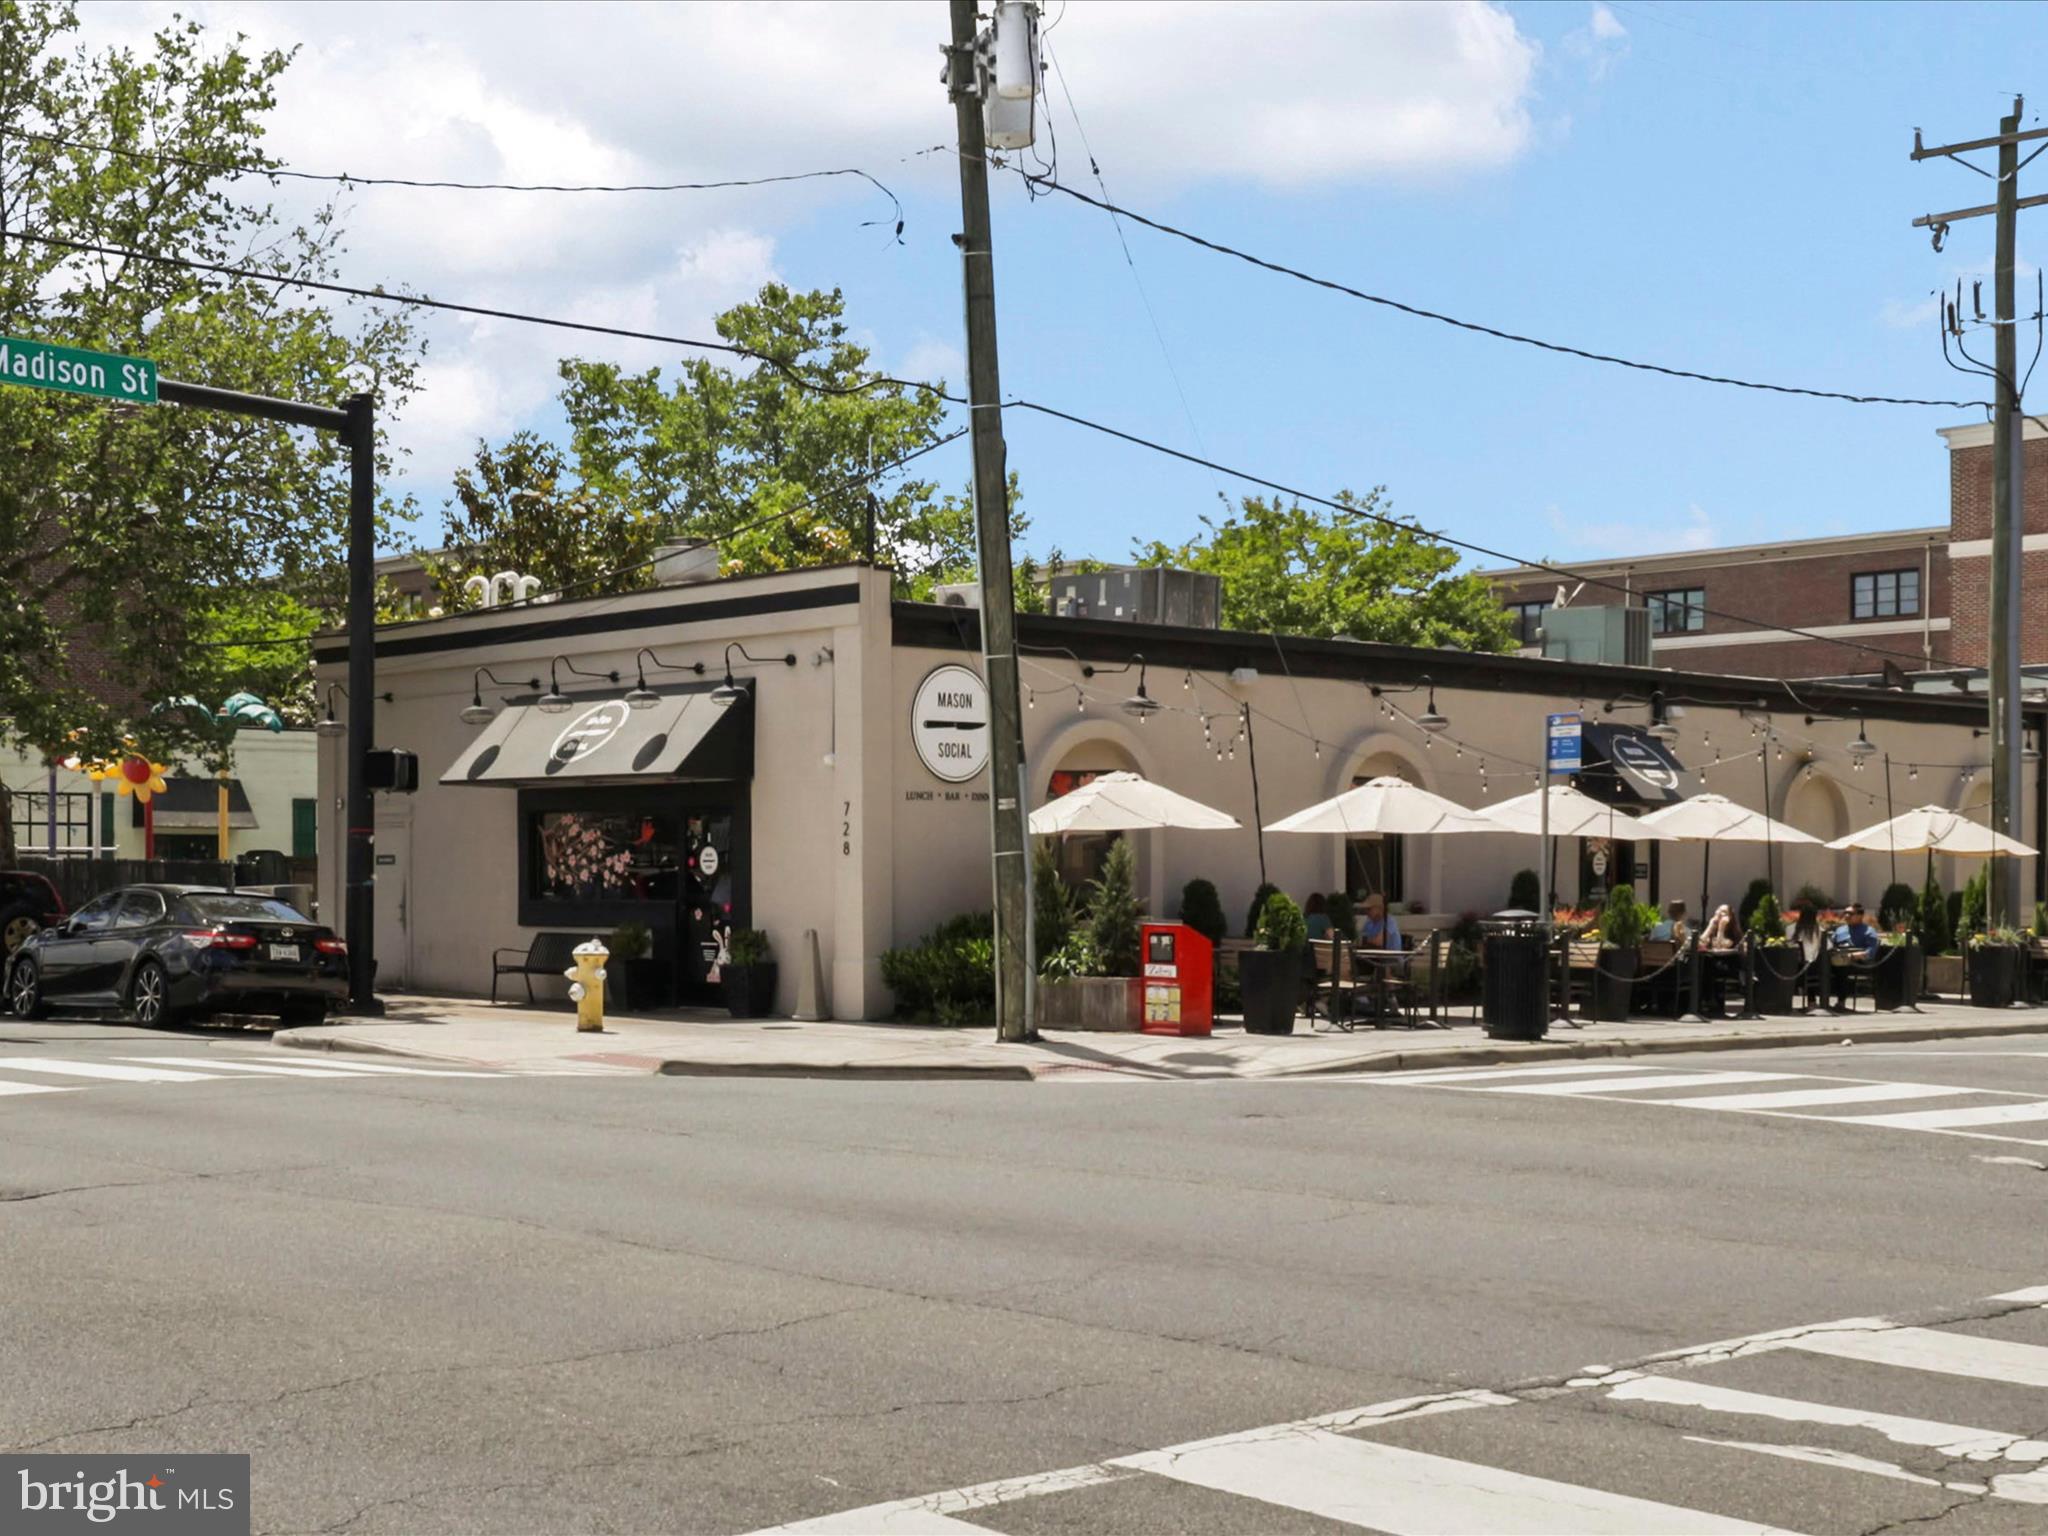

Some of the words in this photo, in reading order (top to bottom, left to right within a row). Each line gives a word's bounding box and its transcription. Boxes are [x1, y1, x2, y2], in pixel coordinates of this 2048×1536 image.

[121, 363, 149, 395] St
[937, 692, 972, 709] MASON
[938, 742, 972, 759] SOCIAL
[905, 791, 933, 801] LUNCH
[945, 791, 960, 801] BAR
